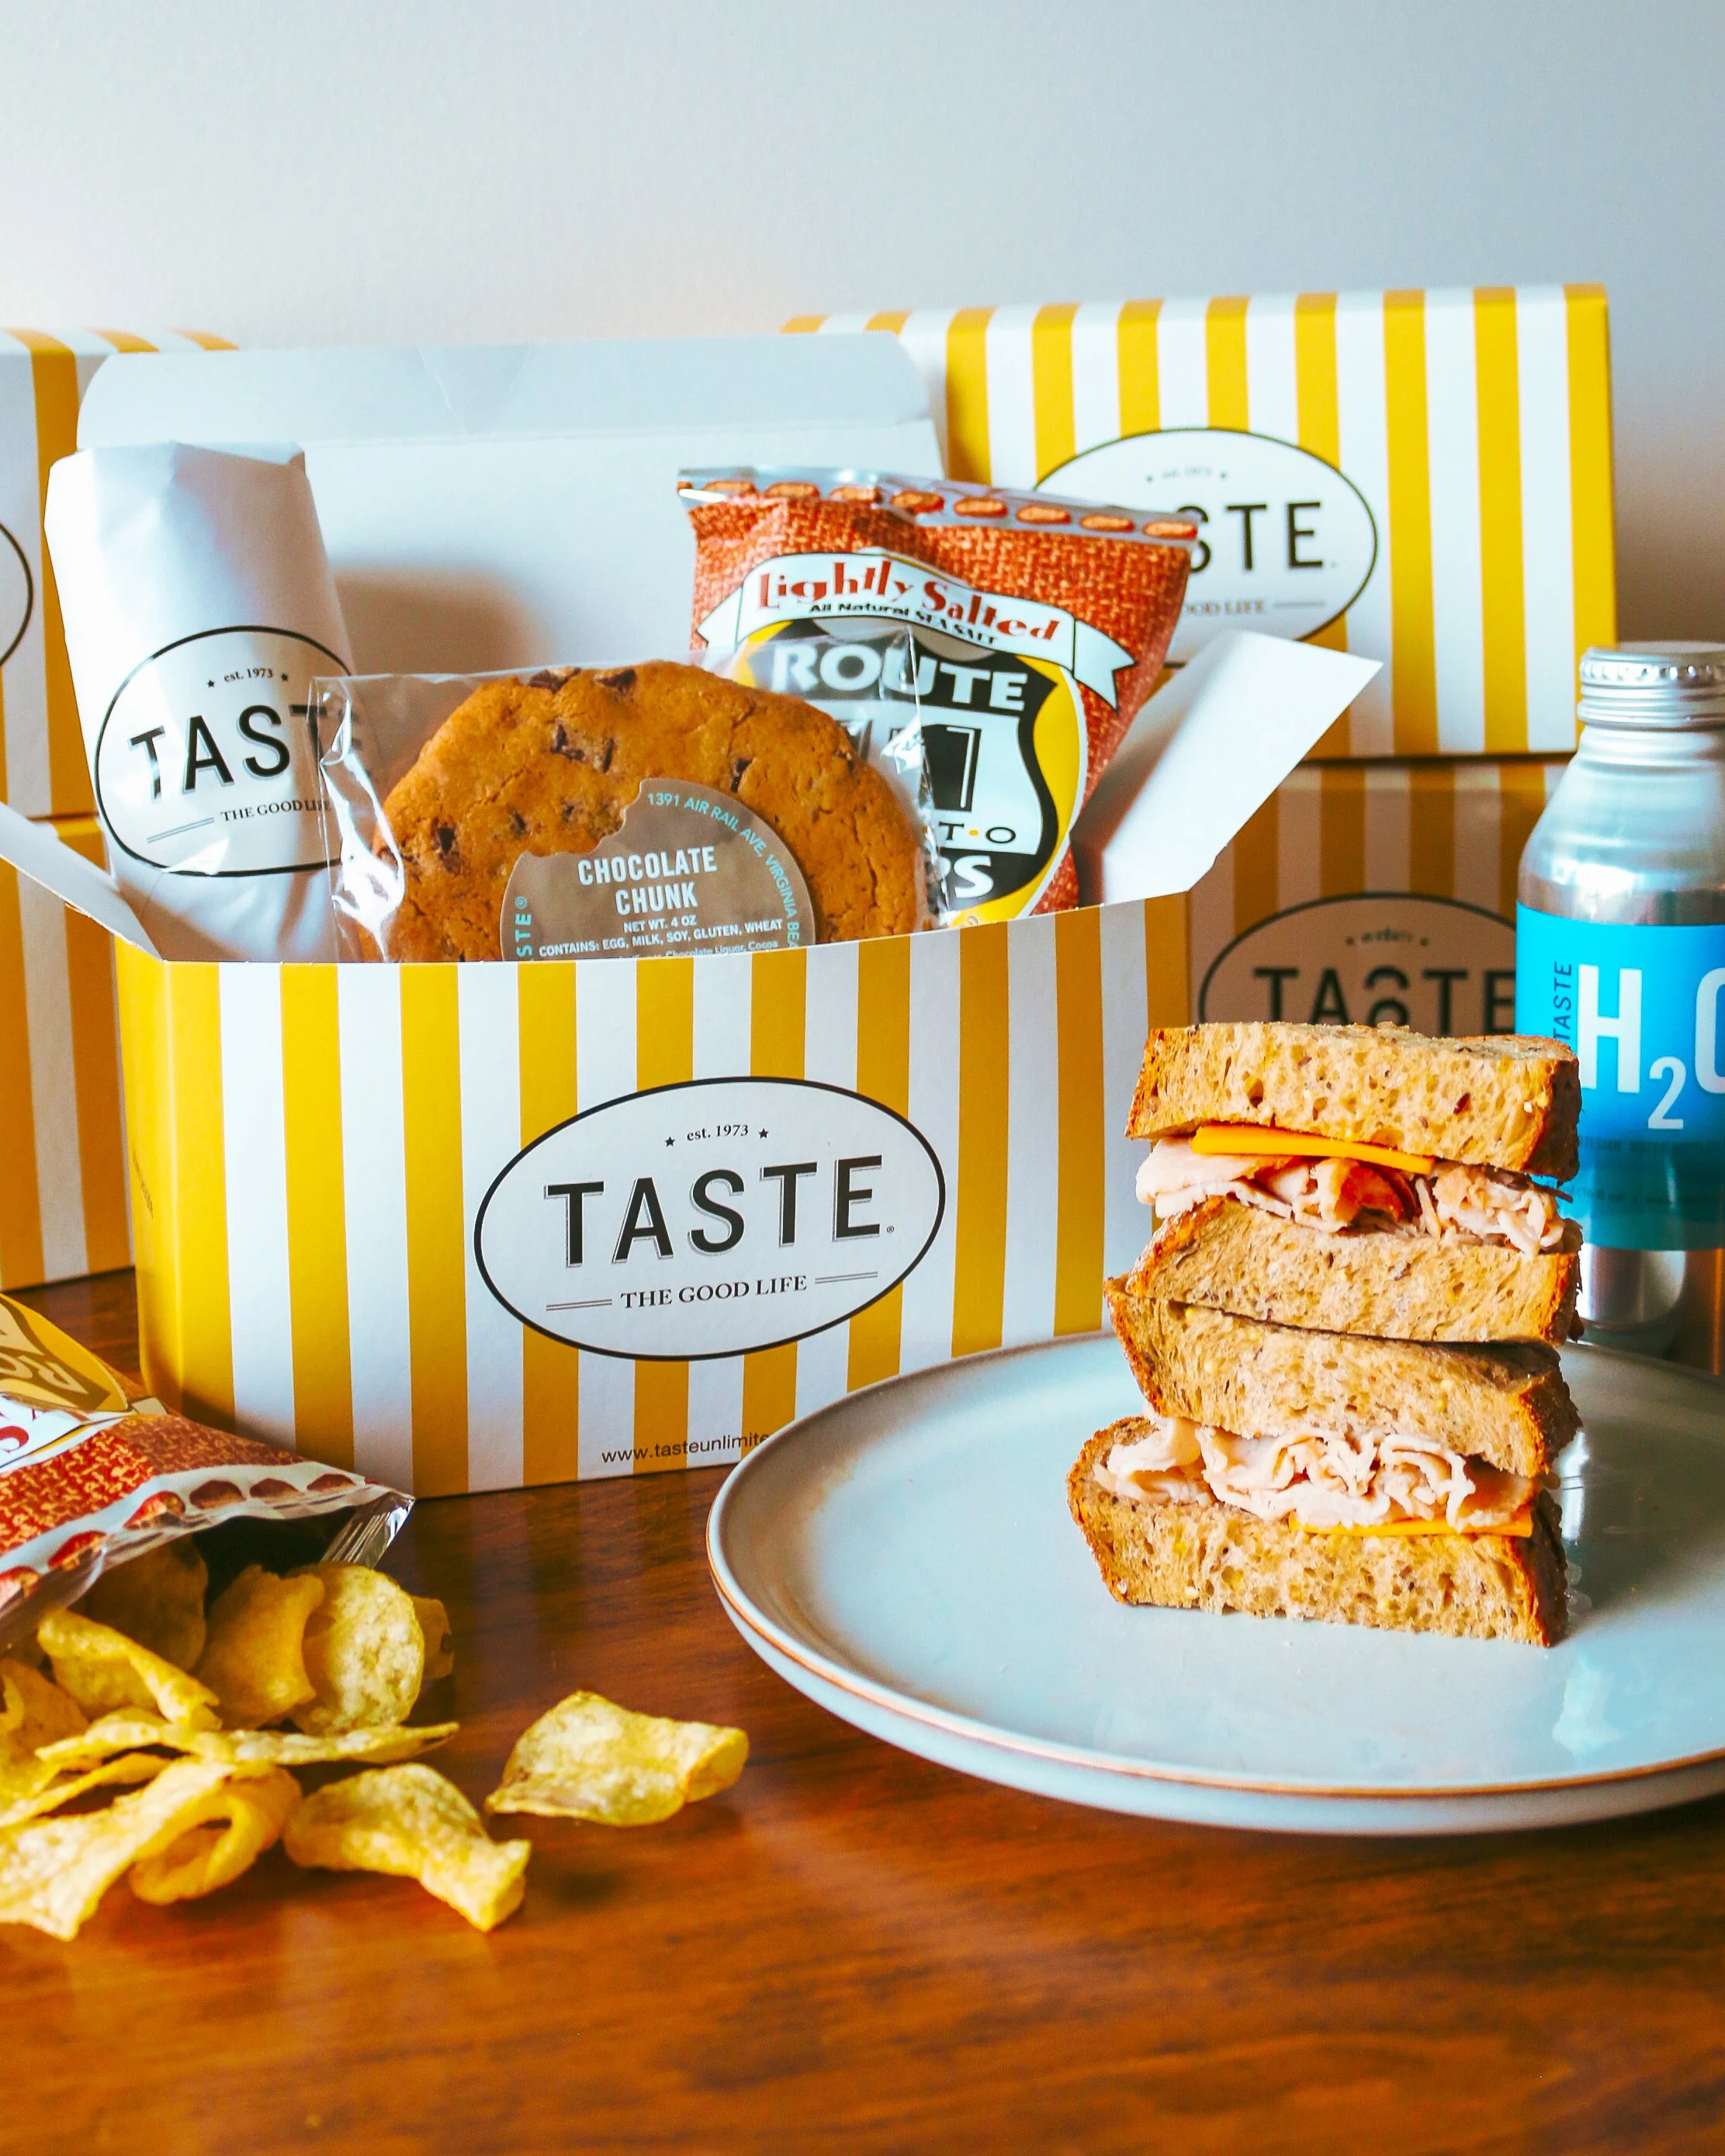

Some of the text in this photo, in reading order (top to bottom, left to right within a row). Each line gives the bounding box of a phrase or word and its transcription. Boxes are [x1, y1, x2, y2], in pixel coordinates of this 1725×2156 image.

[1176, 501, 1323, 573] STE
[757, 559, 1060, 641] Lightly Salted
[809, 602, 831, 612] All
[838, 603, 909, 616] Natural
[223, 667, 274, 682] est. 1973
[771, 643, 1028, 711] ROUTE
[220, 807, 255, 822] THE
[258, 799, 302, 815] GOOD
[577, 846, 718, 886] CHOCOLATE
[647, 792, 680, 807] 1391
[684, 797, 710, 815] AIR
[711, 806, 740, 832] RAIL
[765, 854, 798, 919] VIRGINIA
[787, 922, 801, 947] BEA
[615, 881, 698, 916] CHUNK
[539, 919, 783, 957] CONTAINS: EGG, MILK, SOY, GLUTEN, WHEAT
[623, 914, 697, 933] NET WT. 4 OZ
[1554, 961, 1572, 1041] TASTE
[687, 1124, 750, 1141] est. 1973
[621, 1275, 807, 1309] THE GOOD LIFE
[601, 1431, 770, 1463] www.tasteunlimite
